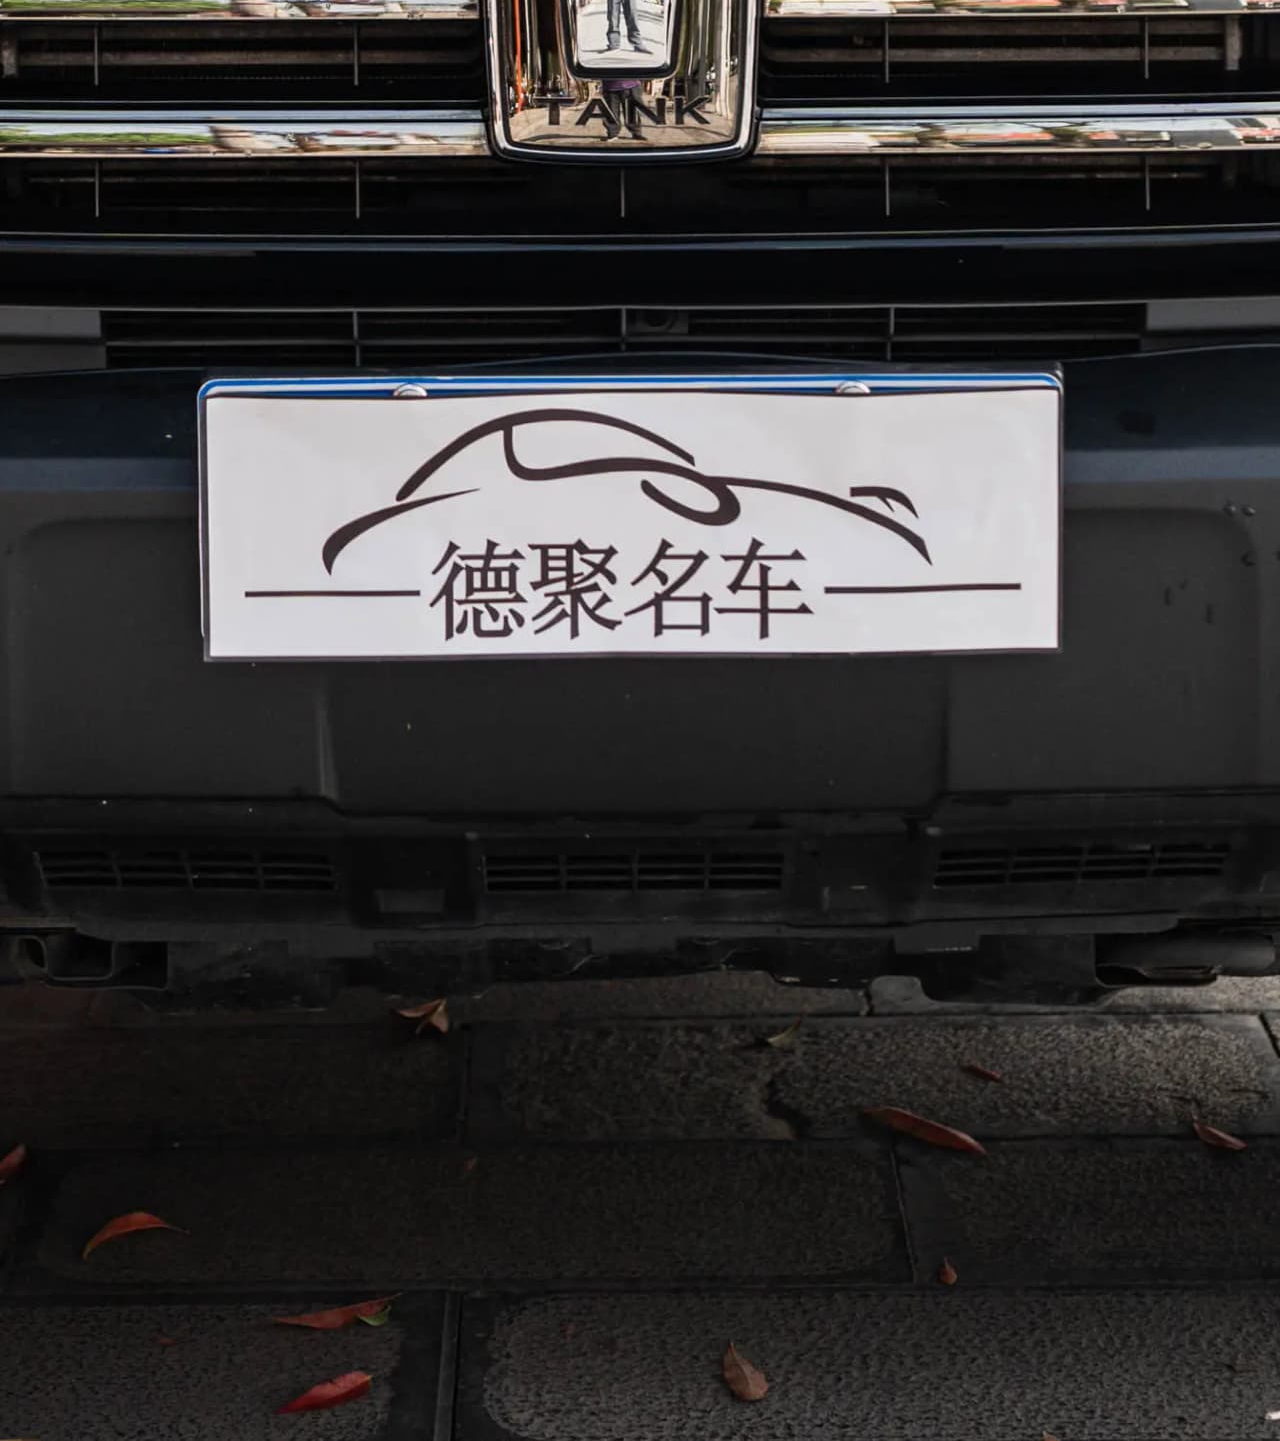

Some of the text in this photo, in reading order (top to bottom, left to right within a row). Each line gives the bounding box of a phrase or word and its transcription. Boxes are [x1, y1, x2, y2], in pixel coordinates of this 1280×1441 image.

[533, 95, 712, 126] TANK
[429, 537, 814, 641] 德聚名车
